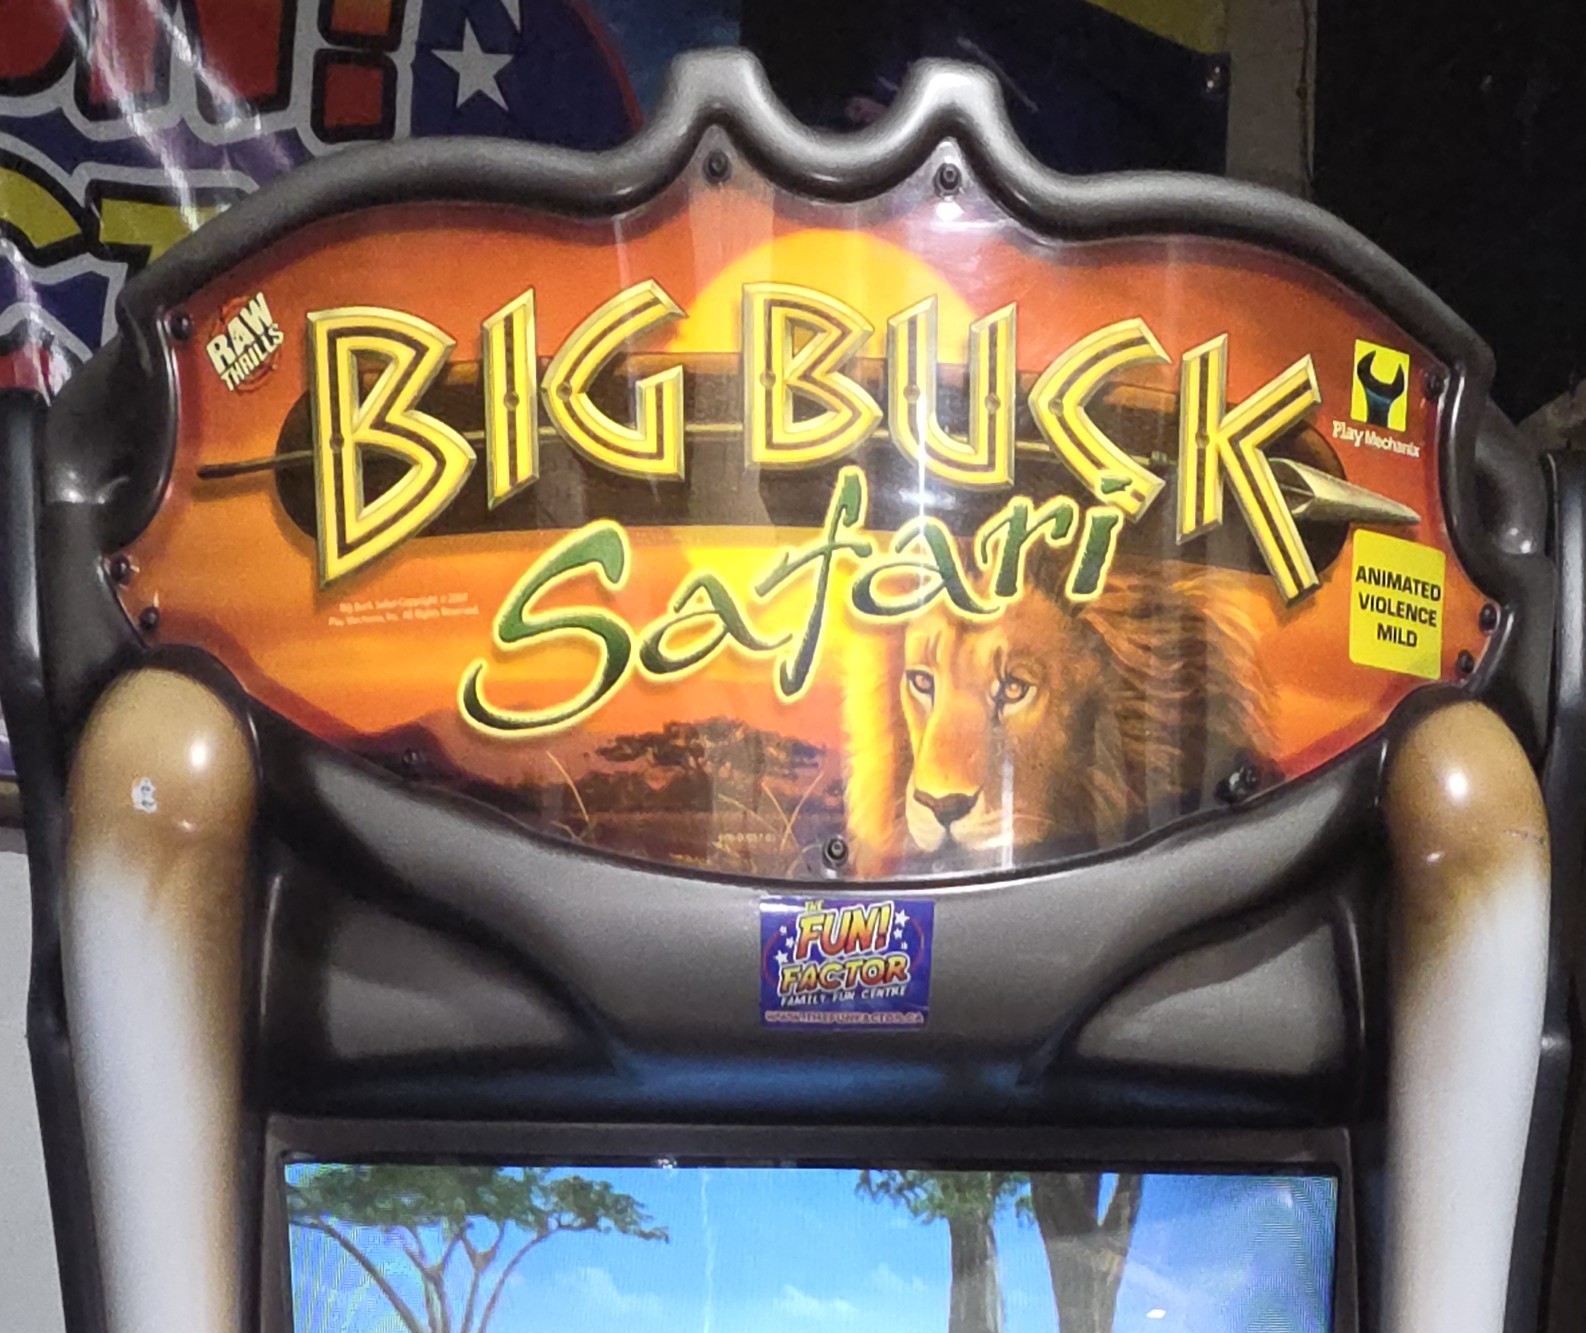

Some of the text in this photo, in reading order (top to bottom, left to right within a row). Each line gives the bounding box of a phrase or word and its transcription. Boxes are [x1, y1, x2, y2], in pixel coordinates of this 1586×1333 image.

[206, 292, 273, 375] RAW
[221, 323, 284, 391] THRILLS
[306, 278, 1321, 608] BIG BUCK
[1332, 420, 1364, 447] Play
[461, 466, 1133, 736] Safari
[1355, 565, 1442, 602] ANIMATED
[1358, 592, 1437, 627] VIOLENCE
[1377, 623, 1418, 648] MILD
[794, 901, 894, 961] FUN!
[778, 952, 911, 996] FACTOR
[780, 985, 908, 1008] FAMILY FUN CENTRE
